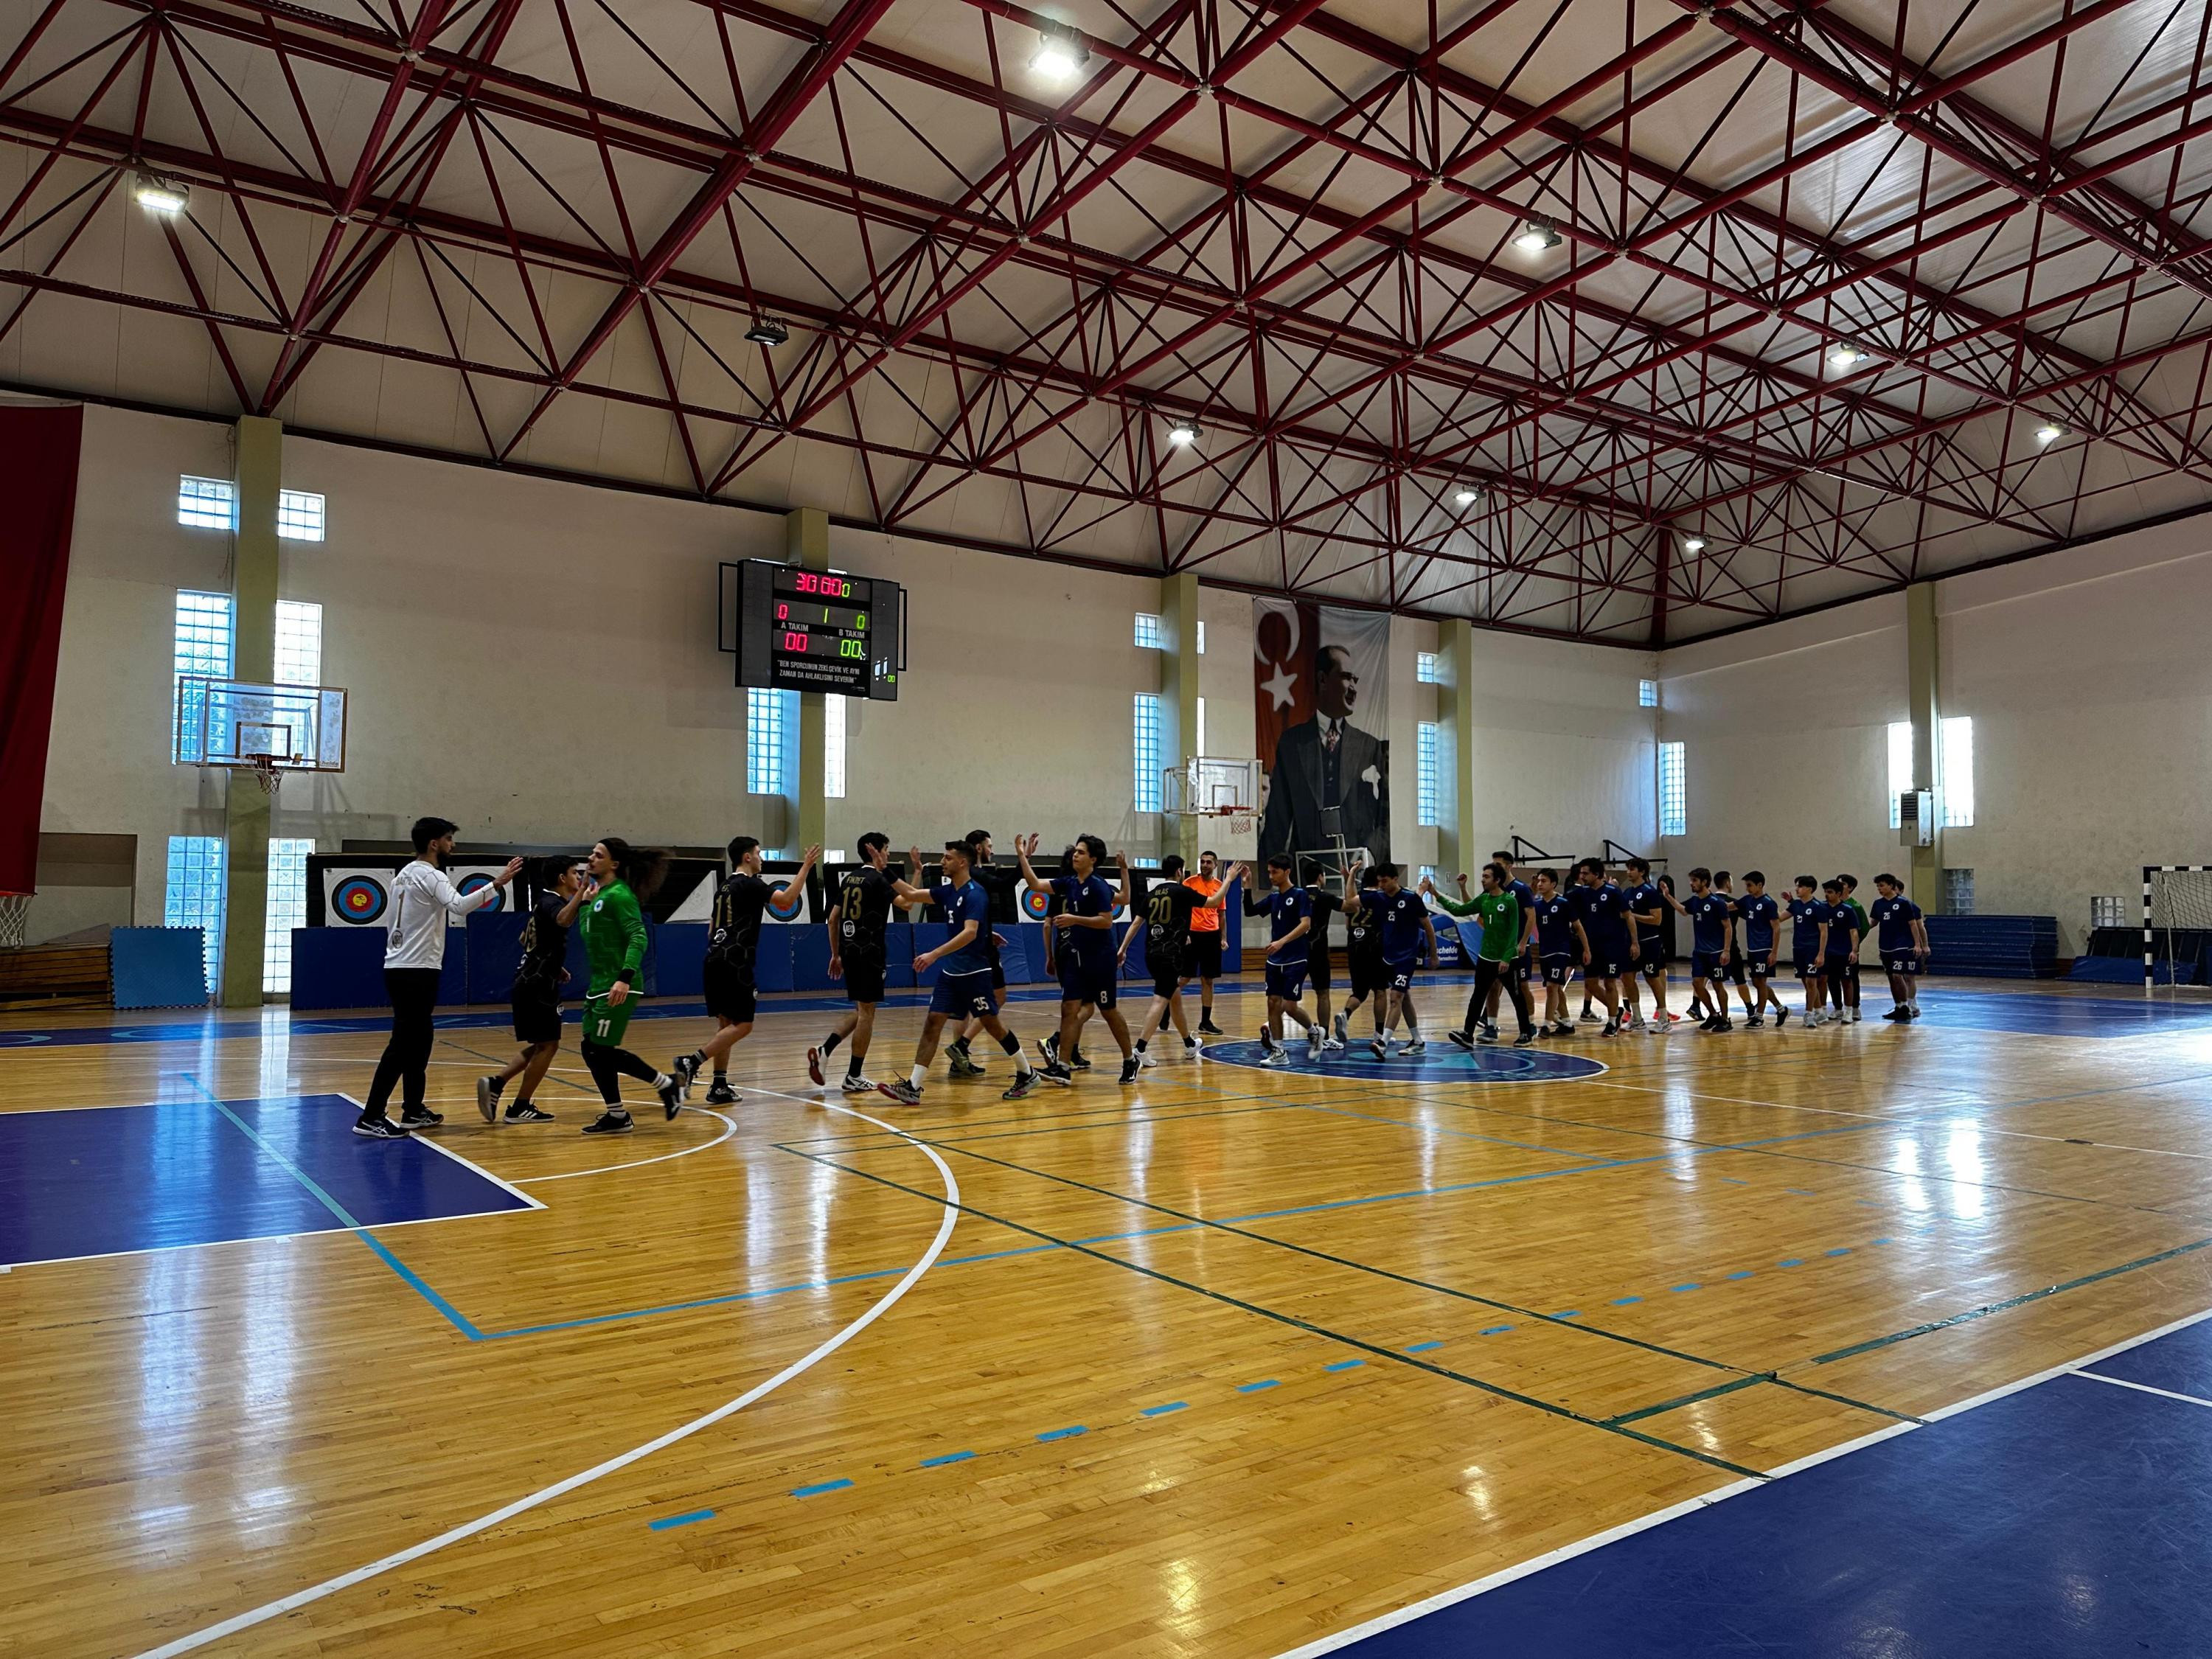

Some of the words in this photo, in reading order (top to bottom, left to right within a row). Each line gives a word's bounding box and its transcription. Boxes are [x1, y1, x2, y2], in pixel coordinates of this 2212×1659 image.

[779, 604, 788, 619] 0
[857, 615, 866, 629] 0
[788, 622, 809, 632] TAKIM
[845, 630, 865, 639] TAKIM
[785, 633, 807, 652] 00
[841, 639, 861, 658] 00
[396, 889, 405, 928] 1
[842, 886, 862, 920] 13
[1591, 903, 1597, 912] 15
[1149, 896, 1172, 925] 20
[1388, 911, 1396, 922] 25
[1609, 964, 1616, 974] 15
[1645, 963, 1654, 973] 42
[1756, 962, 1765, 973] 30
[1846, 967, 1850, 975] 5
[1893, 961, 1902, 970] 26
[1551, 968, 1559, 978] 13
[1714, 967, 1723, 978] 31
[1395, 974, 1408, 987] 25
[1293, 983, 1299, 995] 4
[1100, 991, 1107, 1004] 8
[973, 997, 990, 1011] 35
[597, 1019, 611, 1037] 11
